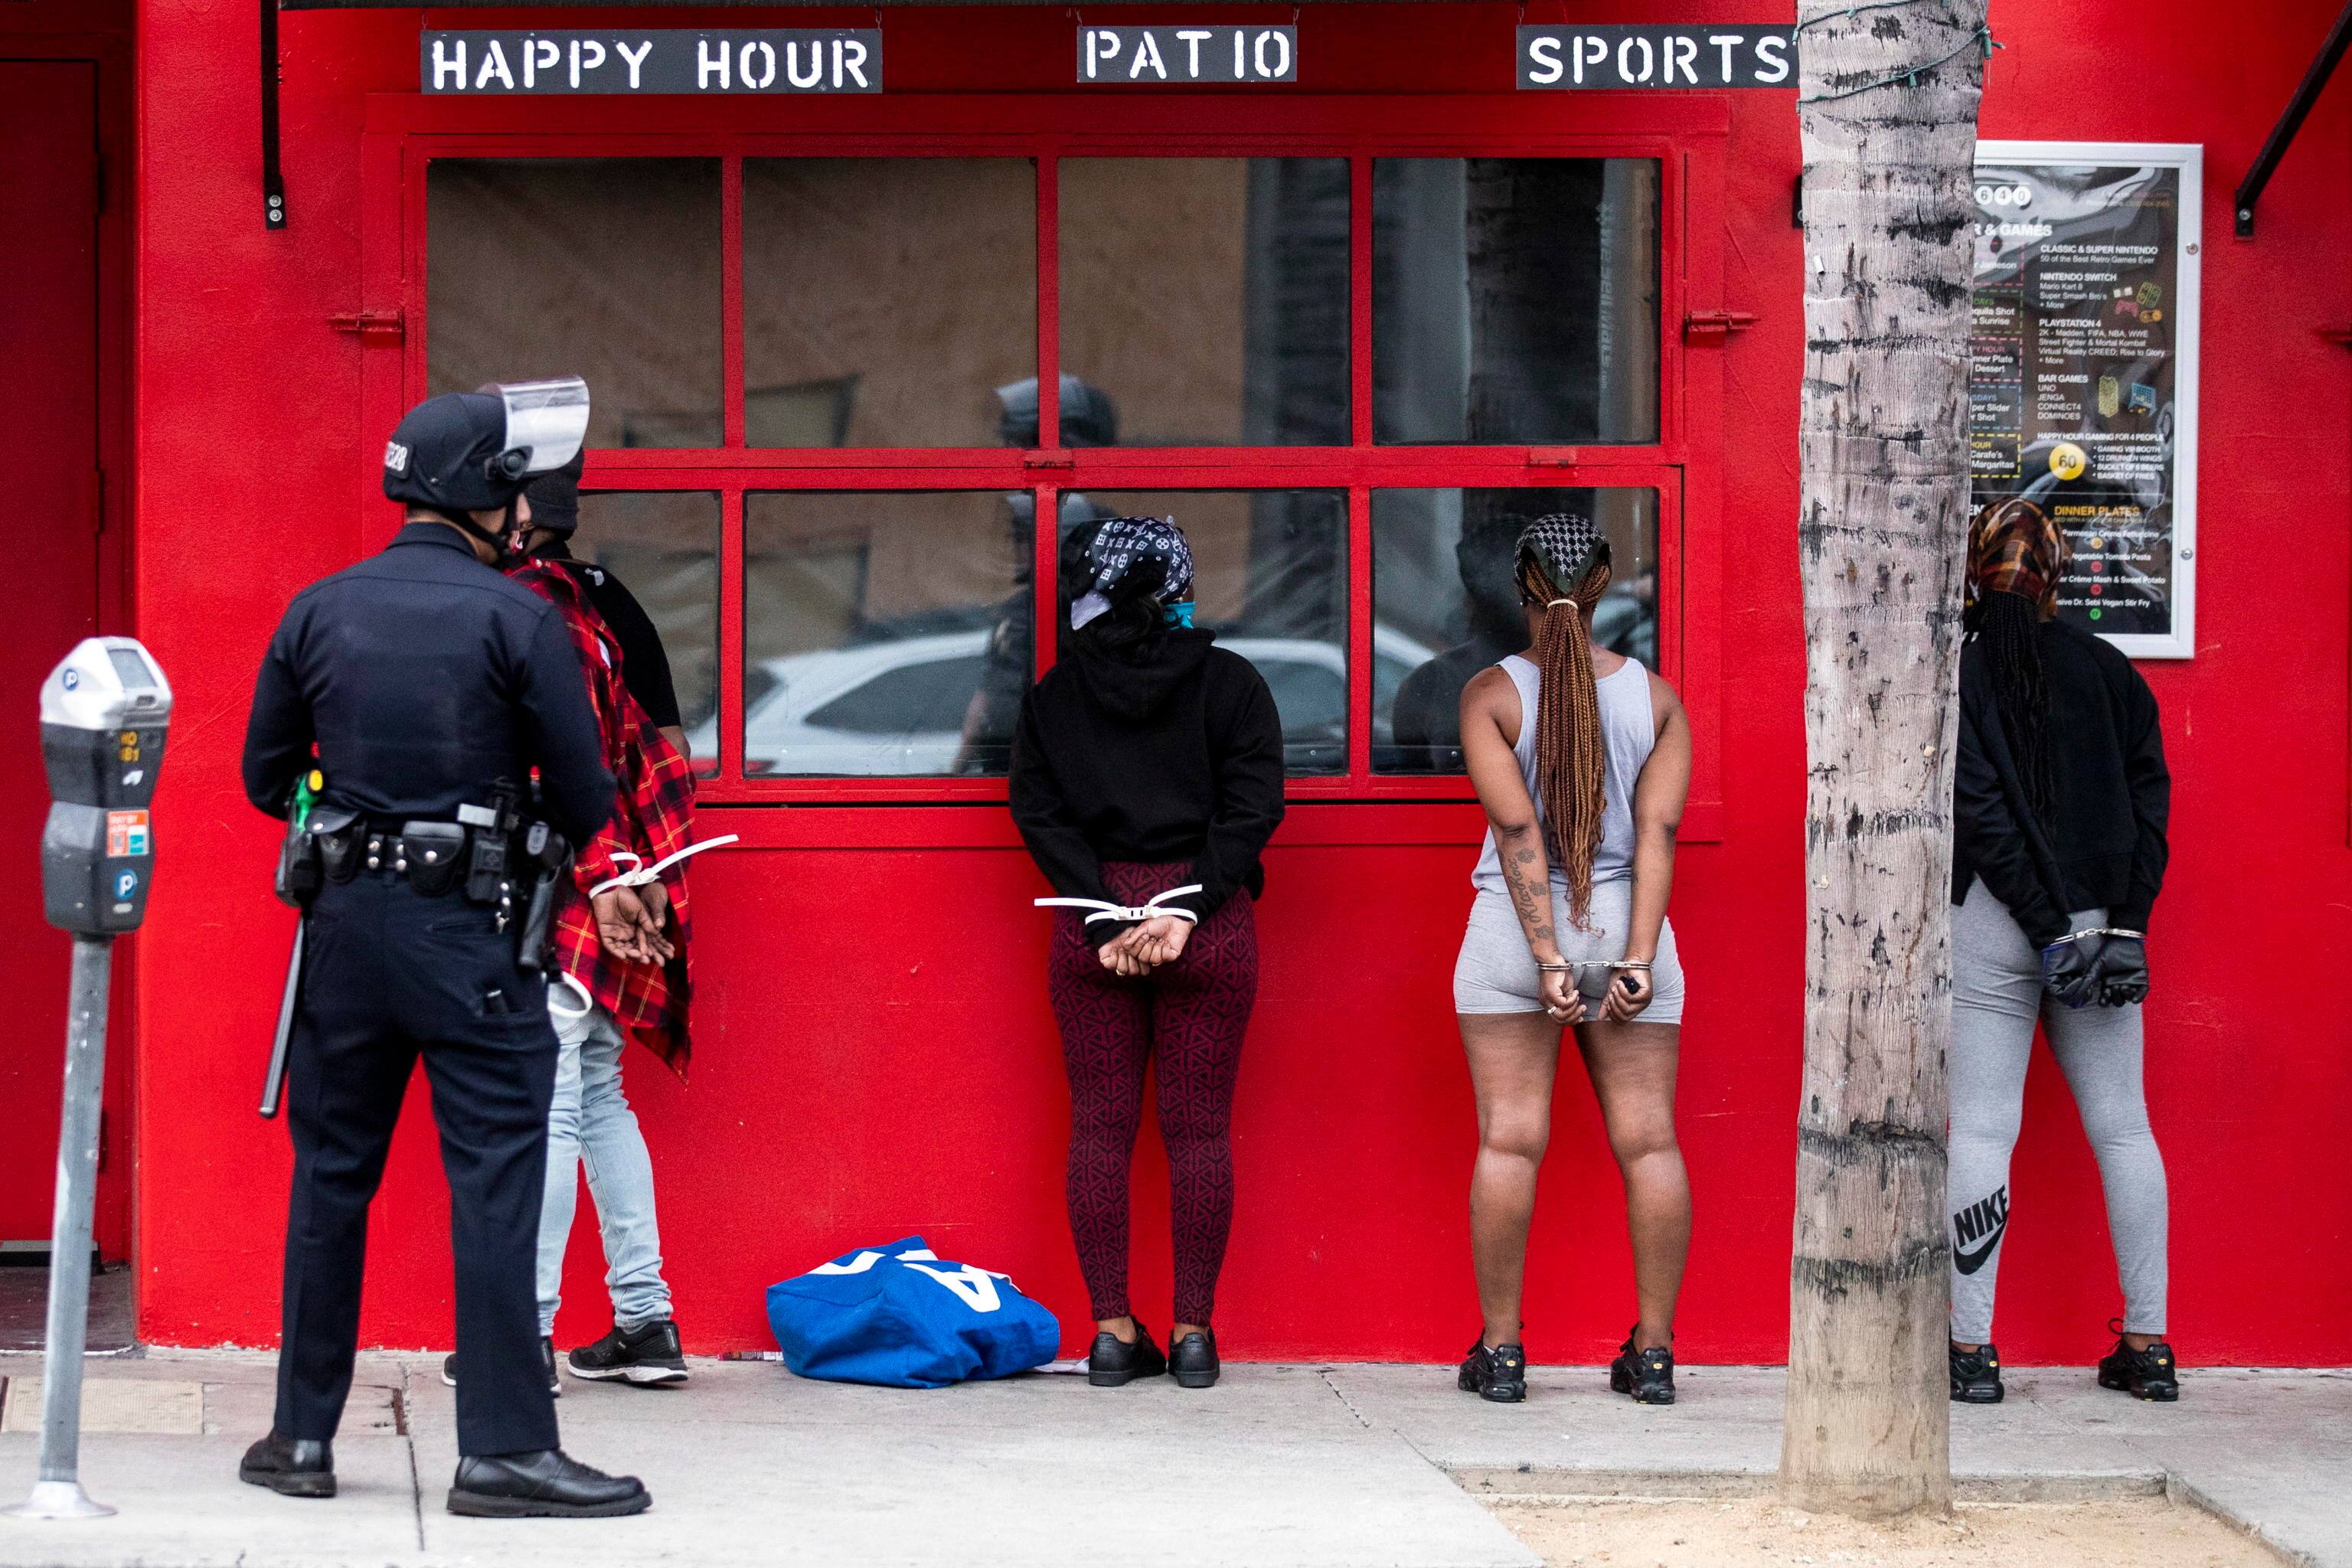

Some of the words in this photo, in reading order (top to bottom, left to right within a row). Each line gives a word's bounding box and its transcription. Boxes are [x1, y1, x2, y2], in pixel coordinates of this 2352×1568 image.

[1086, 29, 1291, 79] PATIO
[1530, 34, 1790, 85] SPORTS
[433, 41, 653, 90] HAPPY
[697, 41, 869, 90] HOUR
[2000, 224, 2053, 237] GAMES
[2040, 245, 2076, 253] CLASSIC
[2078, 245, 2084, 253] &
[2086, 245, 2114, 253] SUPER
[2115, 246, 2158, 255] NINTENDO
[2040, 273, 2083, 281] NINTENDO
[2040, 292, 2060, 300] Super
[1995, 307, 2015, 315] Shot
[1979, 316, 2010, 325] Sunrise
[2039, 318, 2095, 327] PLAYSTATION
[1992, 354, 2014, 364] Plate
[1975, 364, 2004, 373] Dessert
[2038, 374, 2056, 383] BAR
[2058, 374, 2089, 383] GAMES
[1987, 403, 2010, 412] Slider
[1977, 413, 1996, 421] Shot
[1971, 460, 2015, 470] Margaritas
[2059, 455, 2077, 469] 60
[2054, 506, 2096, 515] DINNER
[2098, 506, 2141, 517] PLATES
[1953, 1184, 2009, 1249] NIKE
